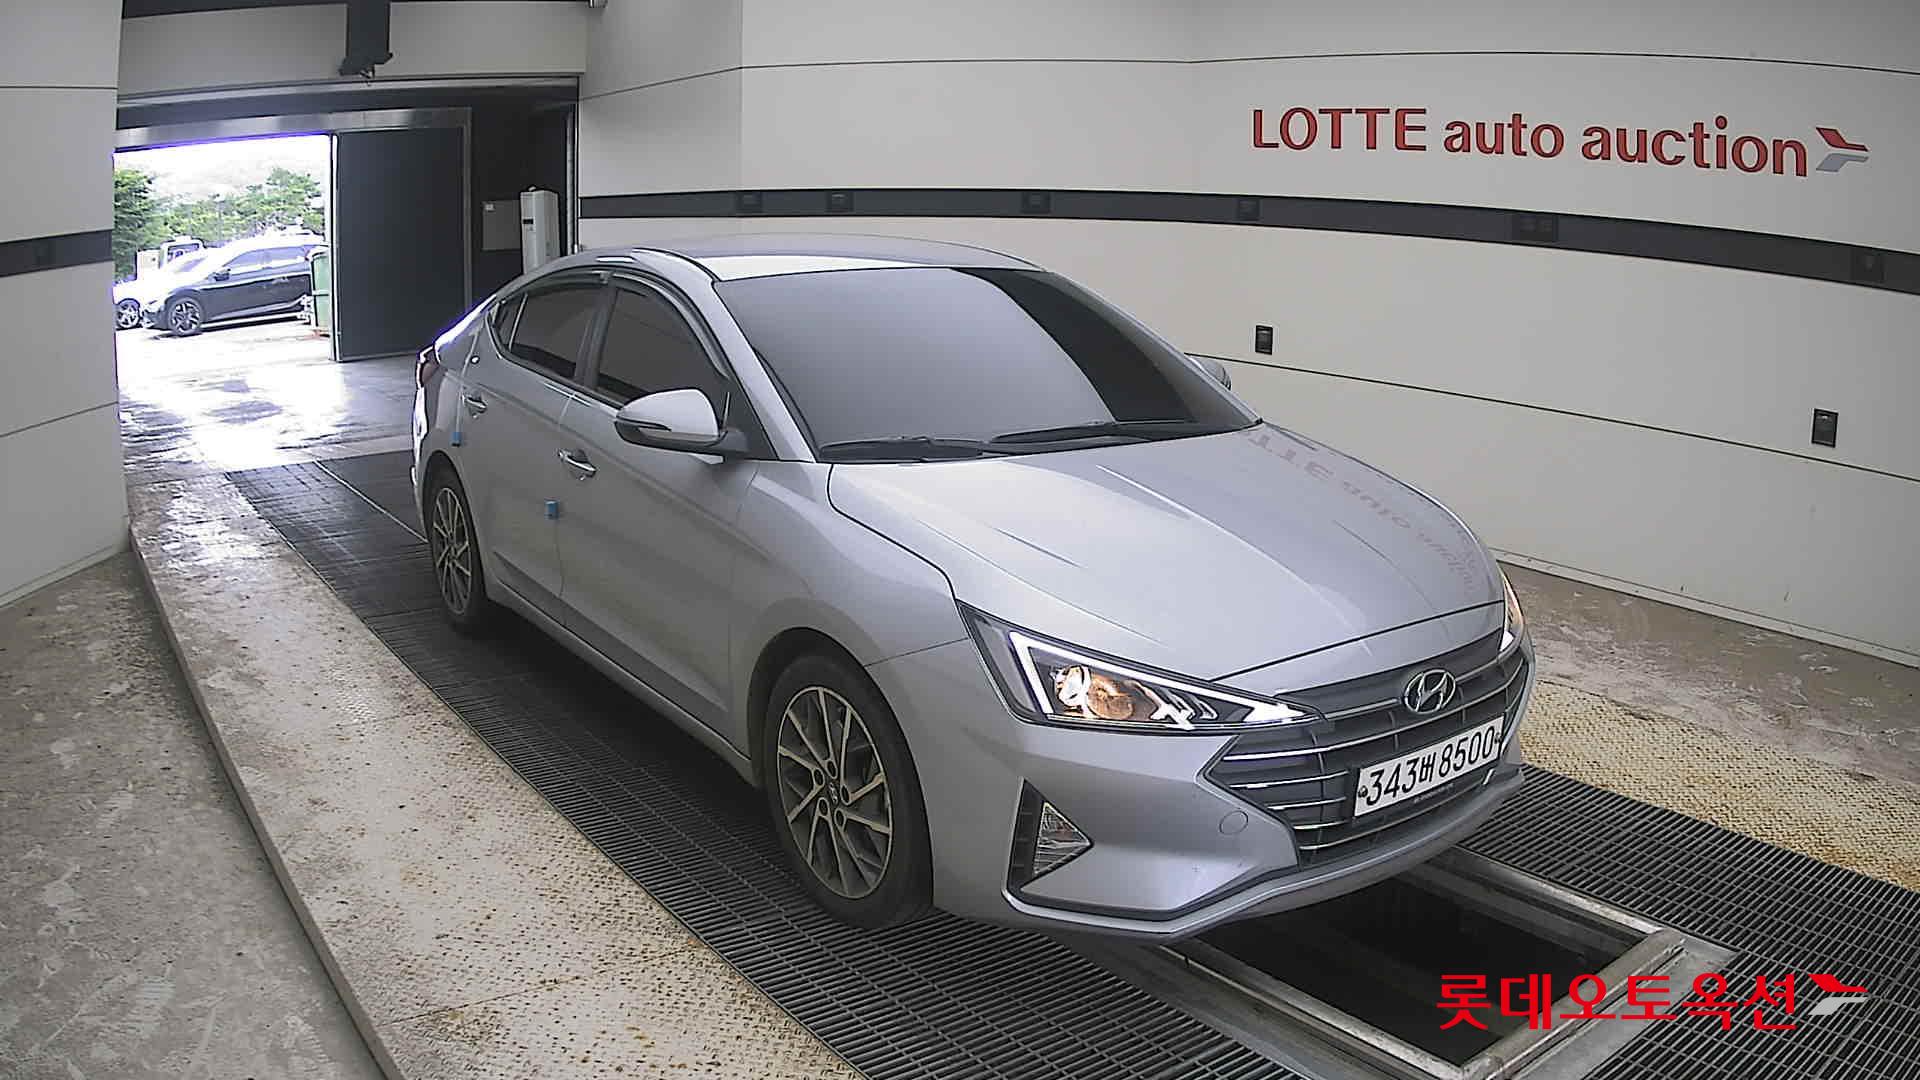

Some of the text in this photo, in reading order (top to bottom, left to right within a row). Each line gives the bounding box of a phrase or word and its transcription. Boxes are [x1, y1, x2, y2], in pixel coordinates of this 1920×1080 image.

[1253, 107, 1808, 178] LOTTE auto auction
[1439, 725, 1495, 778] 8500
